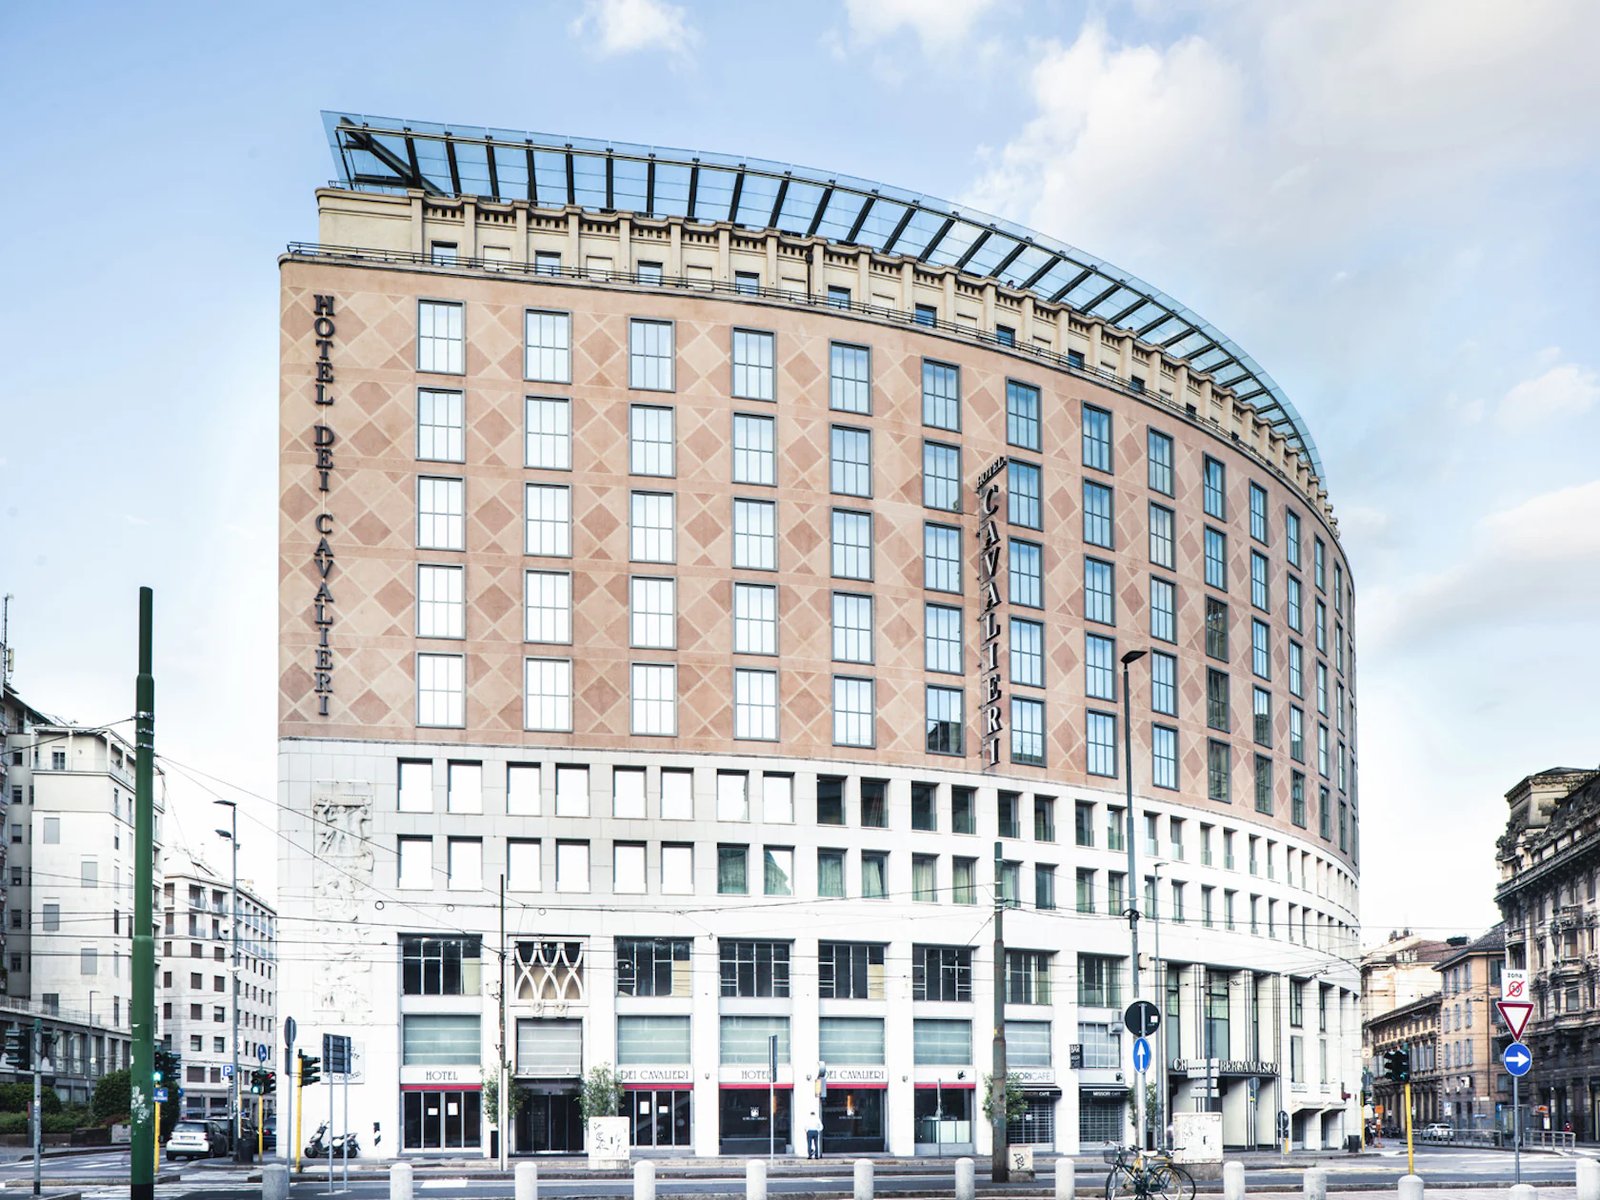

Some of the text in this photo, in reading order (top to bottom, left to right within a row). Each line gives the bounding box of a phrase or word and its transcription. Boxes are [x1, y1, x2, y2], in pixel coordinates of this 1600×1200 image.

[976, 456, 1007, 489] HOTEL
[313, 294, 336, 716] HOTEL DEI CAVALIERI
[982, 484, 1003, 768] CAVALIERI
[224, 1066, 232, 1076] P
[1220, 1060, 1280, 1075] BERGAMASCO
[425, 1070, 459, 1081] HOTEL
[620, 1069, 689, 1080] DEI CAVALIERI
[741, 1070, 771, 1080] HOTEL
[839, 1070, 884, 1080] CAVALIERI
